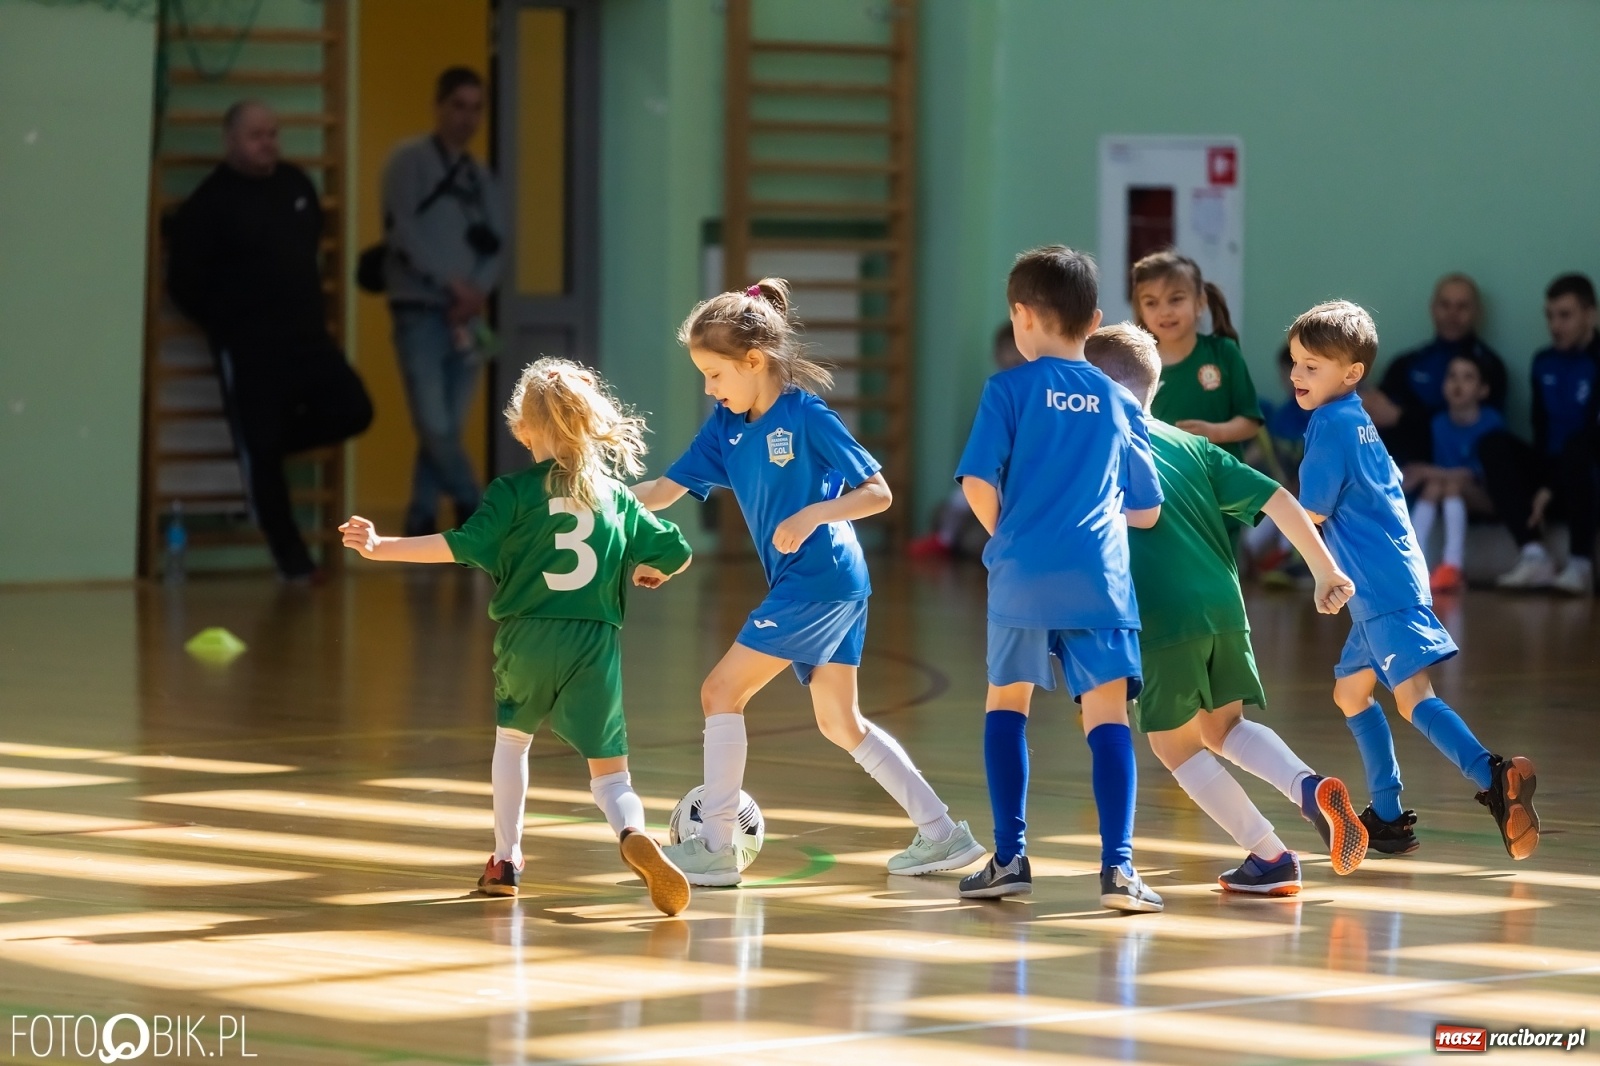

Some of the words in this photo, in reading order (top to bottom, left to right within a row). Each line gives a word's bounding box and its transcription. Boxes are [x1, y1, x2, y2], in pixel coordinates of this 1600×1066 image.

[1046, 388, 1101, 413] IGOR
[773, 447, 788, 455] GOL
[542, 496, 598, 591] 3
